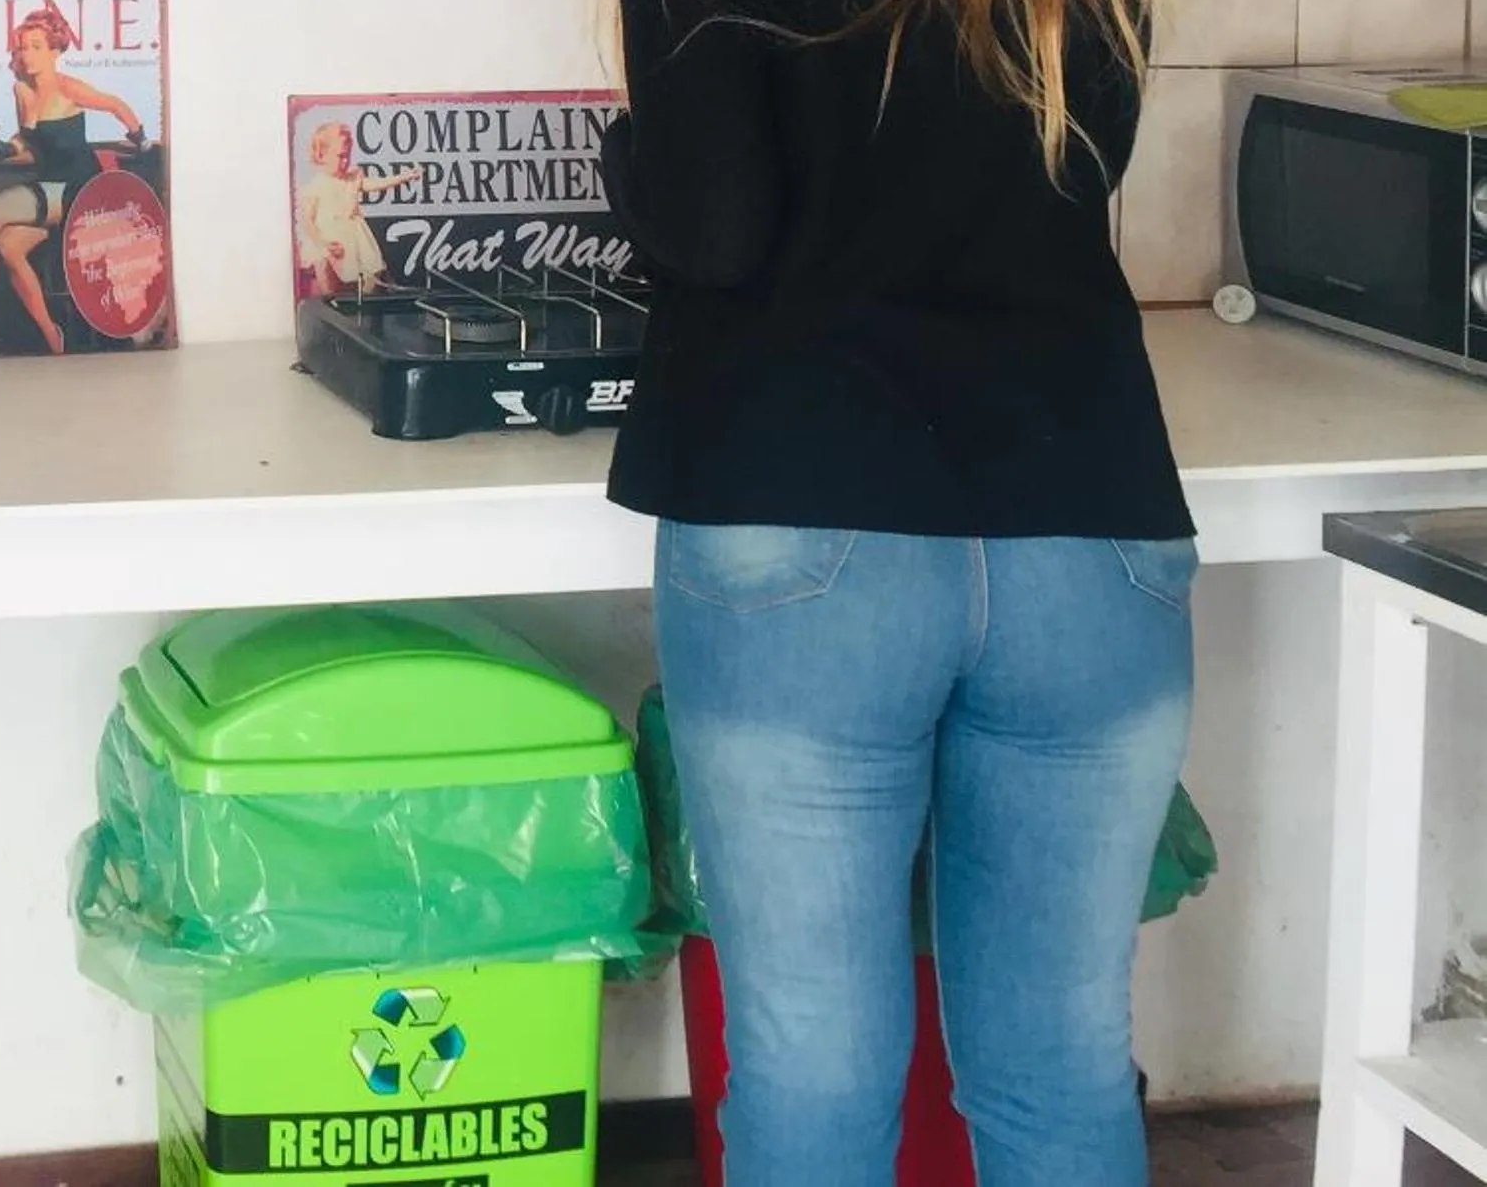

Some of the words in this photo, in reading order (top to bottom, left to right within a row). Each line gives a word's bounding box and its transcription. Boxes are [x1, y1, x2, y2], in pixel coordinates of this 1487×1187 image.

[356, 107, 630, 155] COMPLAIN
[386, 219, 505, 276] That
[514, 220, 635, 282] Way
[269, 1101, 549, 1168] RECICLABLES
